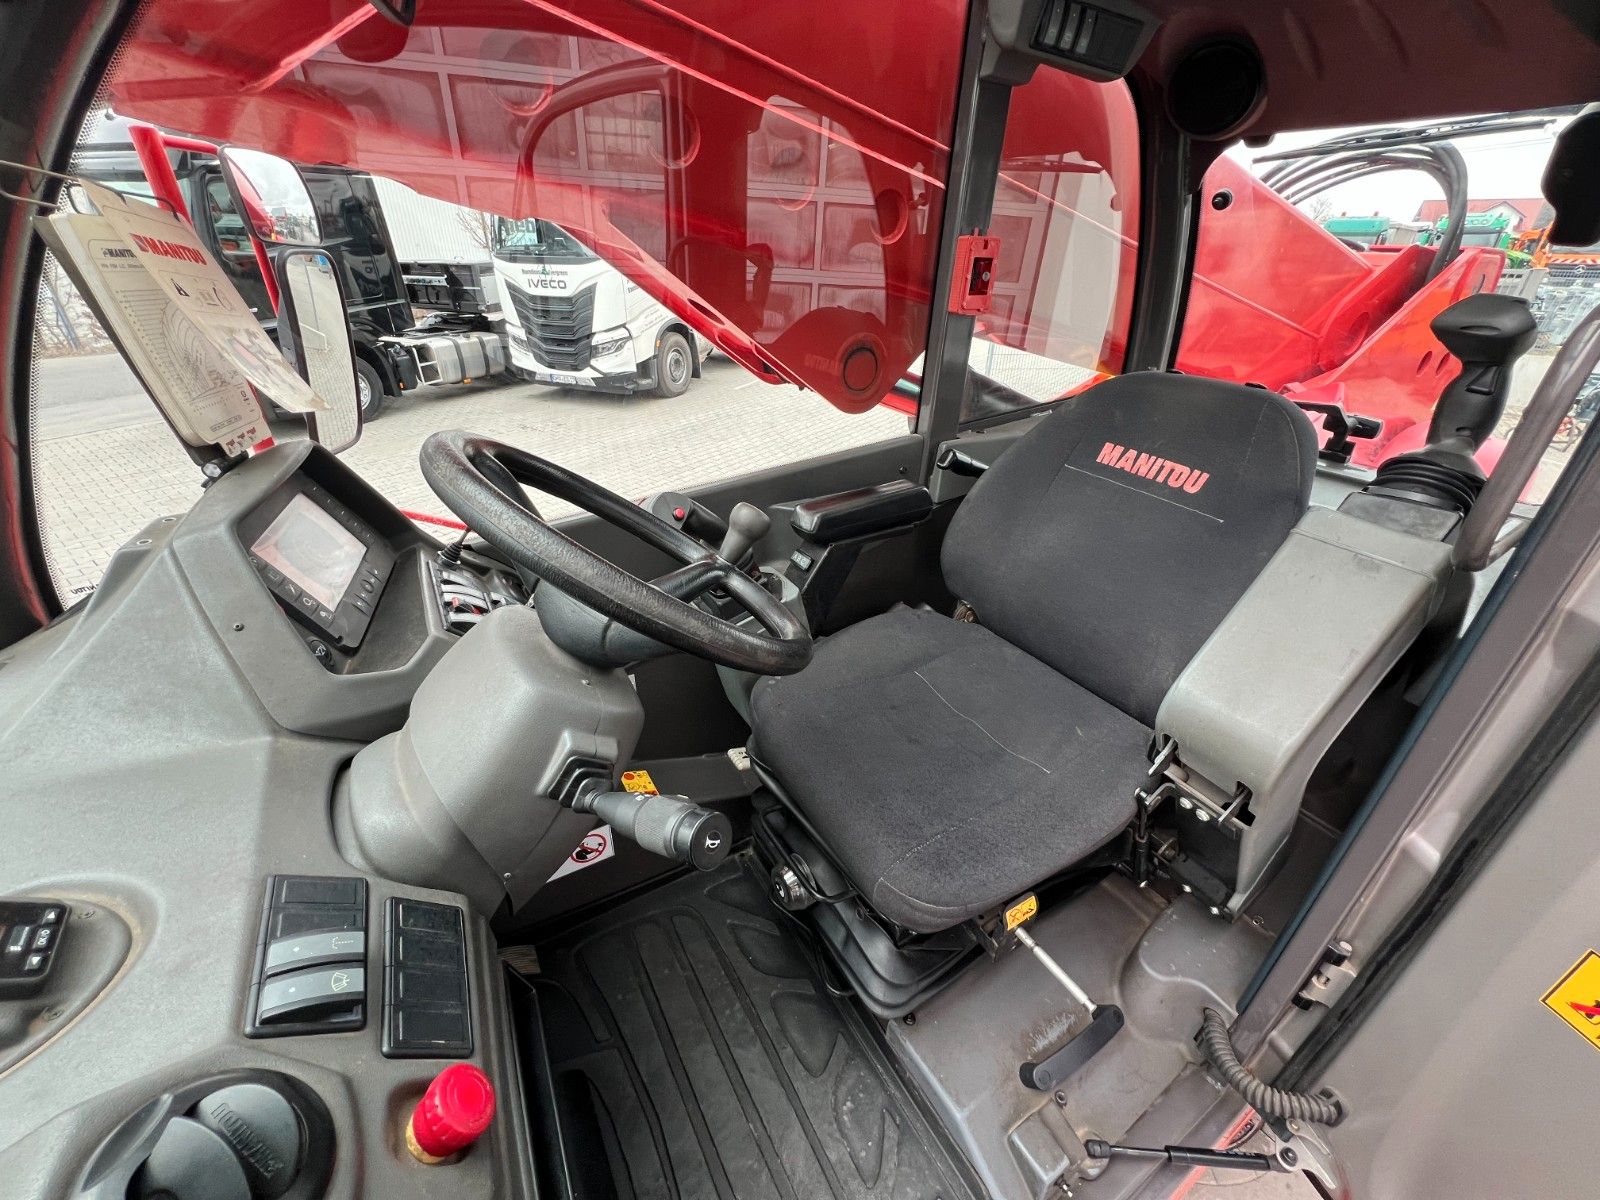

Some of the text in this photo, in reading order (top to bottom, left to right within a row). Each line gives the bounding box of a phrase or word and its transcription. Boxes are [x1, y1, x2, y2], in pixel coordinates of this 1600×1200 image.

[108, 249, 138, 258] MANITO
[145, 236, 207, 265] MANITOU
[528, 278, 567, 289] IVECO
[1095, 442, 1210, 493] MANITOU
